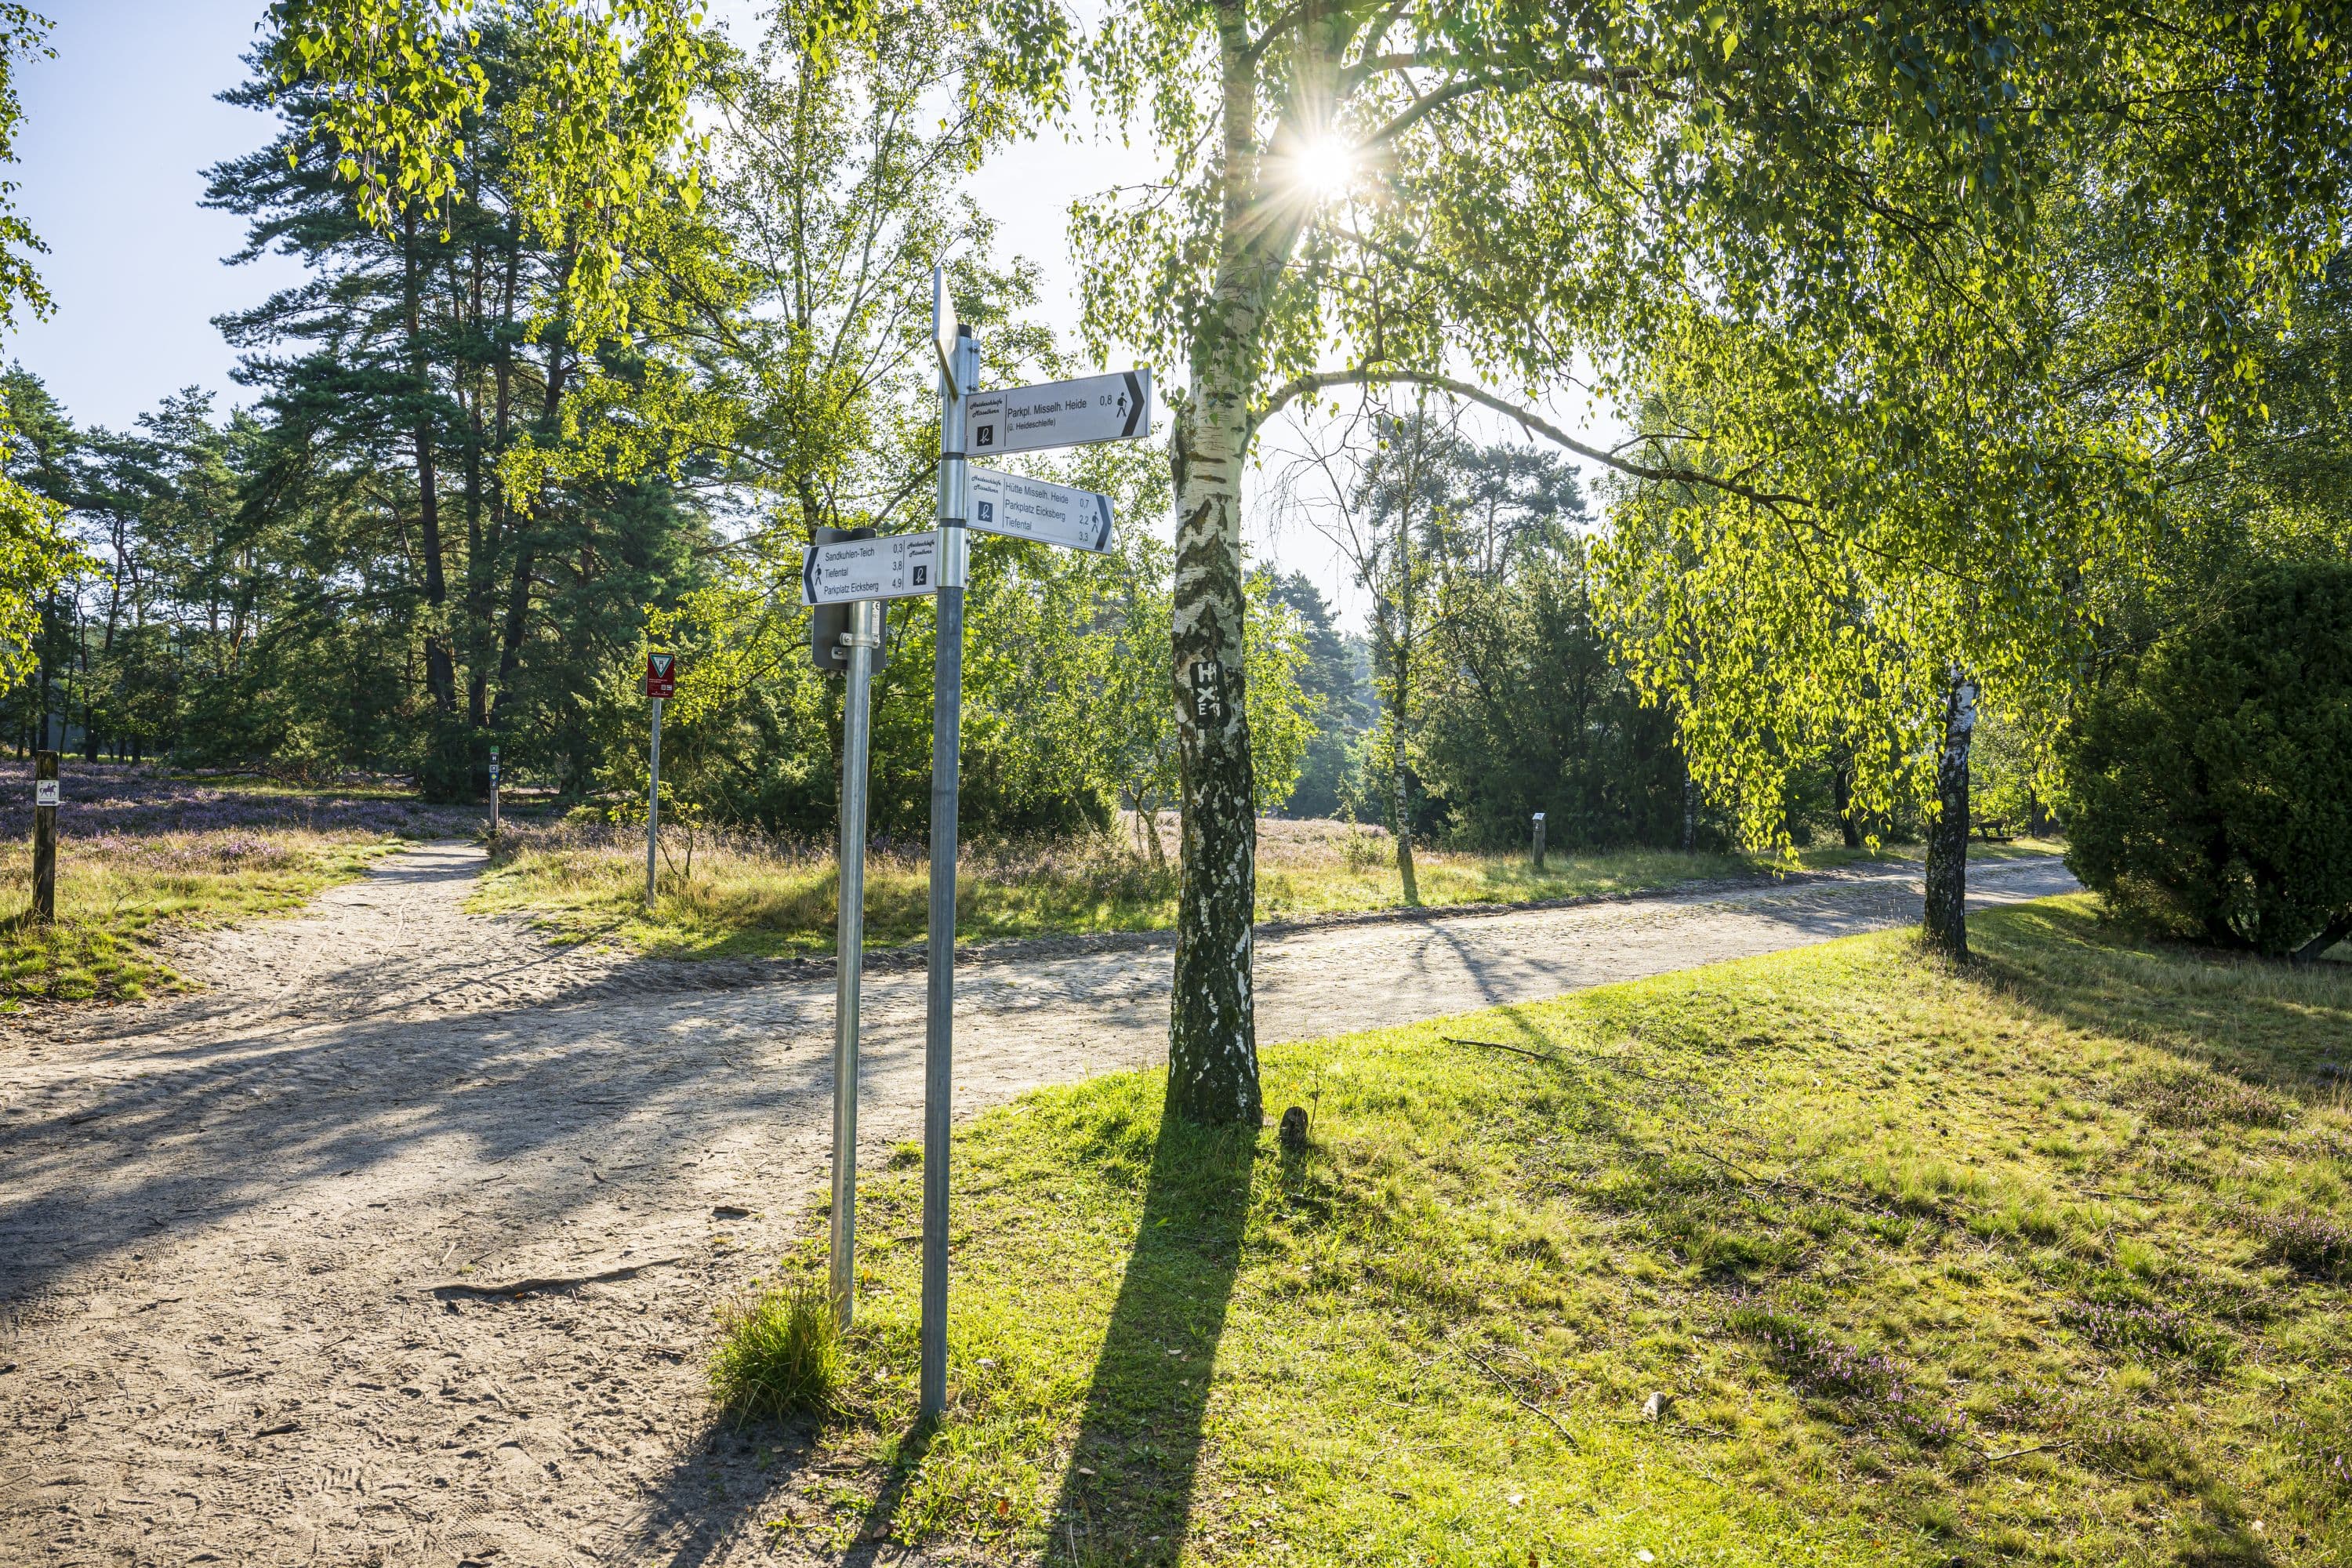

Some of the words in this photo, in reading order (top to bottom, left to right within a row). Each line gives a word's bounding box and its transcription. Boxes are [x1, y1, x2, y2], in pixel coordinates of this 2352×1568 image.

[1007, 406, 1032, 418] Parkpl.
[1033, 401, 1063, 416] Misselh.
[1065, 399, 1087, 411] Heide
[1099, 394, 1112, 408] 0,8
[1015, 419, 1056, 431] Heideschleife)
[1005, 483, 1023, 494] Hütte
[1024, 487, 1050, 500] Misselh.
[1051, 492, 1069, 504] Heide
[1080, 498, 1089, 509] 0,7
[1005, 499, 1035, 514] Parkplatz
[1036, 506, 1066, 523] Eicksberg
[1079, 514, 1089, 525] 2,2
[1005, 516, 1032, 531] Tiefental
[1079, 532, 1089, 543] 3,3
[825, 547, 875, 561] Sandkuhlen-Teich
[893, 543, 902, 554] 0,3
[825, 568, 849, 579] Tiefental
[892, 561, 902, 572] 3,8
[824, 583, 850, 597] Parkplatz
[851, 582, 880, 593] Eicksberg
[891, 578, 902, 589] 4,9
